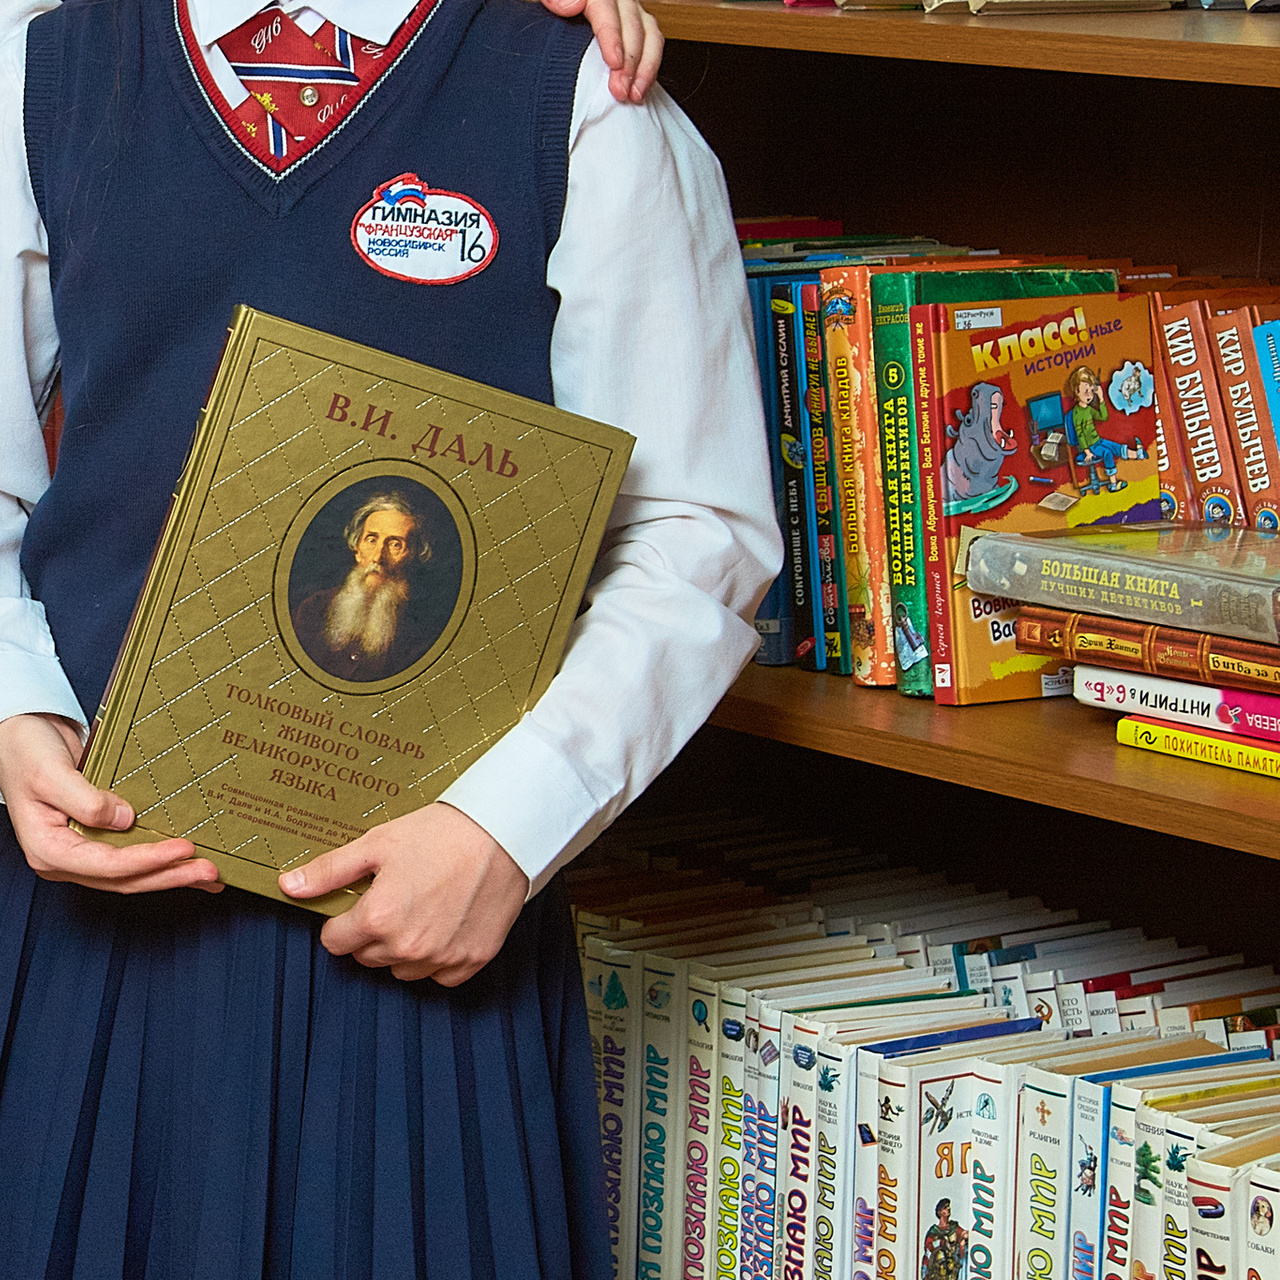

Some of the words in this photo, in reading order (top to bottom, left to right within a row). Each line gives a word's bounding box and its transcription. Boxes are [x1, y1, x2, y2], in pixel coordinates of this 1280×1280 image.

[359, 223, 458, 241] "ФРАНЦУЗСКАЯ"
[372, 207, 480, 228] ГИМНАЗИЯ
[367, 247, 409, 258] РОССИЯ
[368, 238, 445, 252] НОВОСИБИРСК
[459, 229, 486, 263] 16
[778, 320, 788, 366] СУСЛИН
[804, 310, 818, 356] БЫВАЕТ
[916, 322, 924, 334] же
[1163, 317, 1197, 366] КИР
[808, 357, 819, 370] НЕ
[916, 338, 926, 364] такие
[1024, 343, 1096, 376] истории
[1216, 326, 1246, 376] КИР
[889, 368, 898, 383] 5
[919, 366, 930, 398] другие
[809, 373, 823, 424] КАНИКУЛ
[325, 392, 397, 440] В.И.
[412, 423, 519, 478] ДАЛЬ
[884, 398, 898, 472] КНИГА
[921, 411, 931, 444] Белкин
[1175, 370, 1223, 483] БУЛЫЧЕВ
[1229, 380, 1271, 493] БУЛЫЧЕВ
[897, 396, 914, 504] ДЕТЕКТИВОВ
[922, 446, 932, 469] Вася
[812, 427, 828, 515] СЫЩИКОВ
[788, 480, 798, 512] НЕБА
[791, 516, 799, 524] С
[888, 478, 903, 586] БОЛЬШАЯ
[902, 511, 915, 586] ЛУЧШИХ
[929, 536, 939, 562] Вовка
[792, 529, 804, 605] СОКРОВИЩЕ
[1041, 559, 1120, 588] БОЛЬШАЯ
[1125, 574, 1180, 600] КНИГА
[1041, 580, 1096, 599] ЛУЧШИХ
[1101, 591, 1183, 615] ДЕТЕКТИВОВ
[1078, 635, 1104, 649] Эрин
[1105, 638, 1140, 655] Хантер
[1139, 690, 1211, 717] ИНТРИГИ
[226, 683, 334, 730] ТОЛКОВЫЙ
[340, 721, 426, 760] СЛОВАРЬ
[277, 724, 359, 761] ЖИВОГО
[1164, 735, 1232, 763] ПОХИТИТЕЛЬ
[221, 729, 400, 797] ВЕЛИКОРУССКОГО
[269, 769, 337, 801] ЯЗЫКА
[221, 783, 284, 809] Совмещенная
[286, 804, 330, 823] редакция
[229, 797, 253, 810] Даля
[286, 815, 324, 833] Бодуэна
[237, 811, 298, 836] современном
[1061, 998, 1078, 1007] КТО
[646, 1043, 669, 1116] МИР
[1028, 1130, 1061, 1147] РЕЛИГИИ
[641, 1122, 666, 1255] ПОЗНАЮ
[972, 1159, 995, 1237] МИР
[1030, 1152, 1057, 1241] МИР
[1246, 1240, 1276, 1255] СОБАКИ
